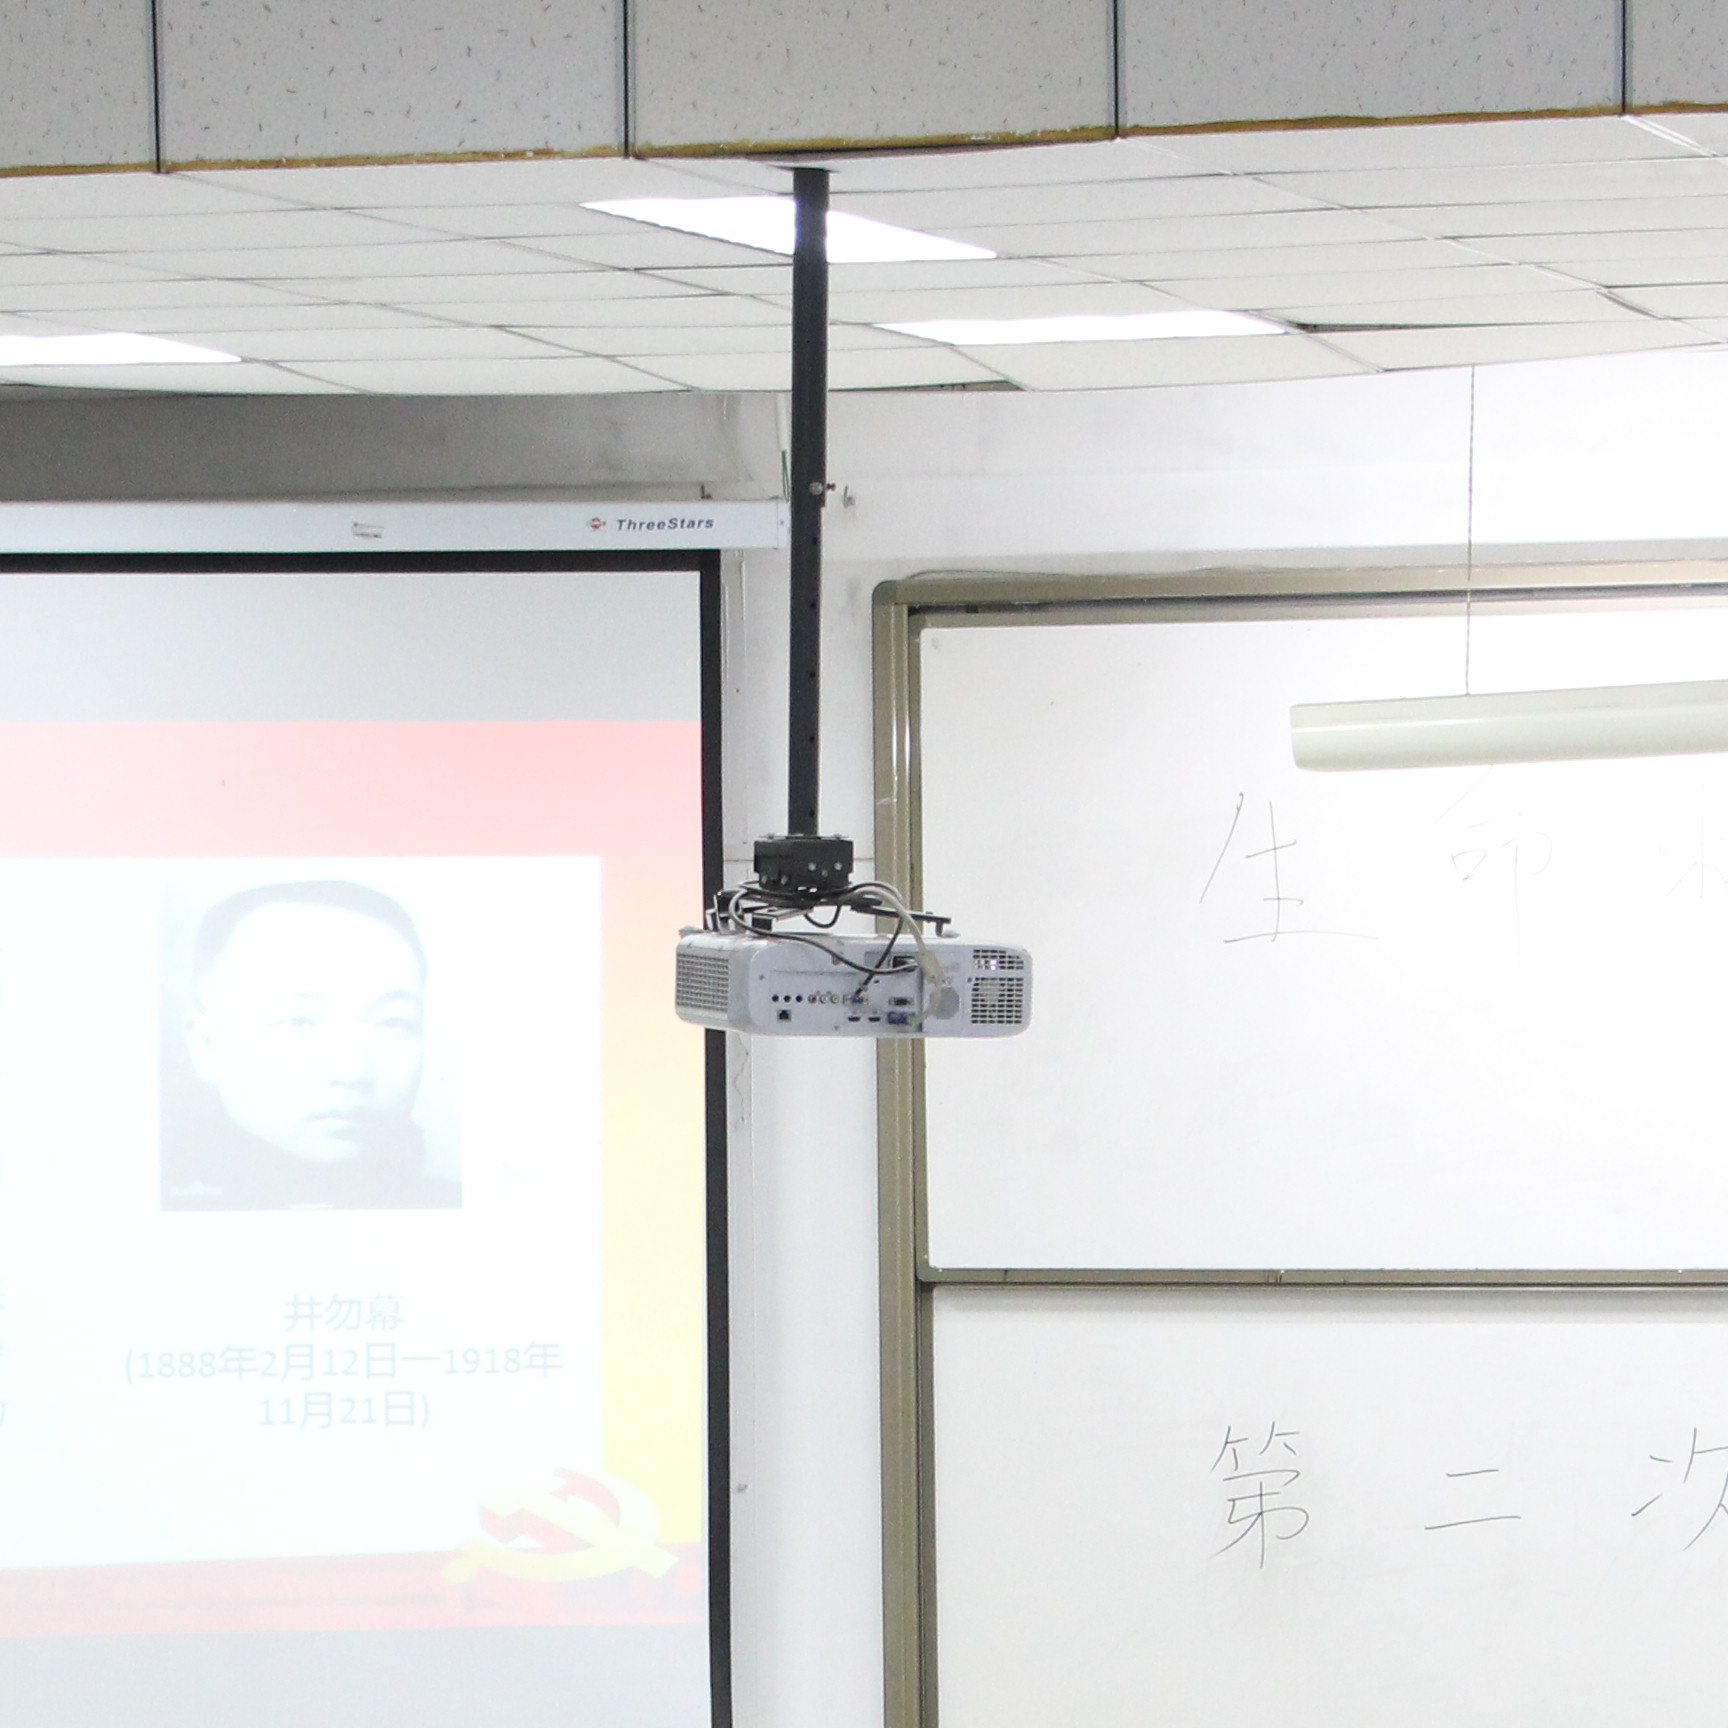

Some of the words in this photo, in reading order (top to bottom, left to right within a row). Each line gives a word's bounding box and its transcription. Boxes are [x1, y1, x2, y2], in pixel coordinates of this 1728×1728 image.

[617, 517, 714, 530] ThreeStars
[283, 1292, 406, 1333] 井勿幕
